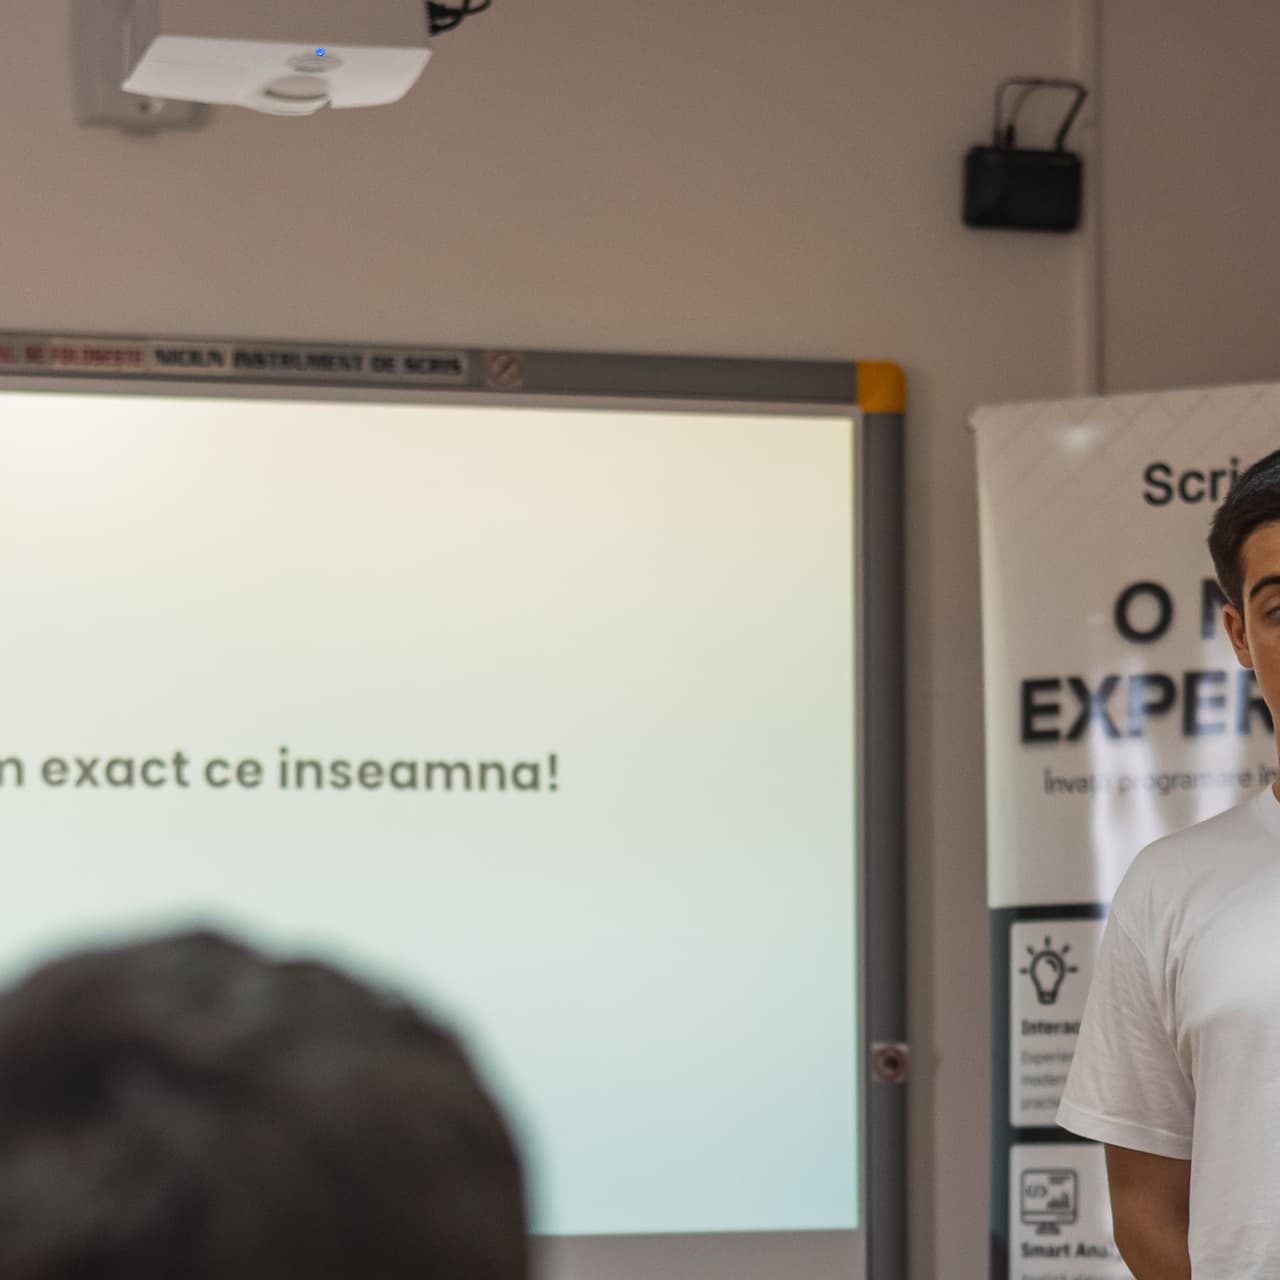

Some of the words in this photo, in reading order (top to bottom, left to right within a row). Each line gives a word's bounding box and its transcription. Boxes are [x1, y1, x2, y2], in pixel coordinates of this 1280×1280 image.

[231, 351, 364, 372] INSTRUMENT
[371, 355, 397, 373] DE
[403, 356, 462, 375] SCRIS
[1115, 582, 1173, 644] O
[41, 750, 190, 789] exact
[204, 757, 264, 789] ce
[279, 746, 560, 793] inseamna!
[1021, 1241, 1070, 1258] Smart
